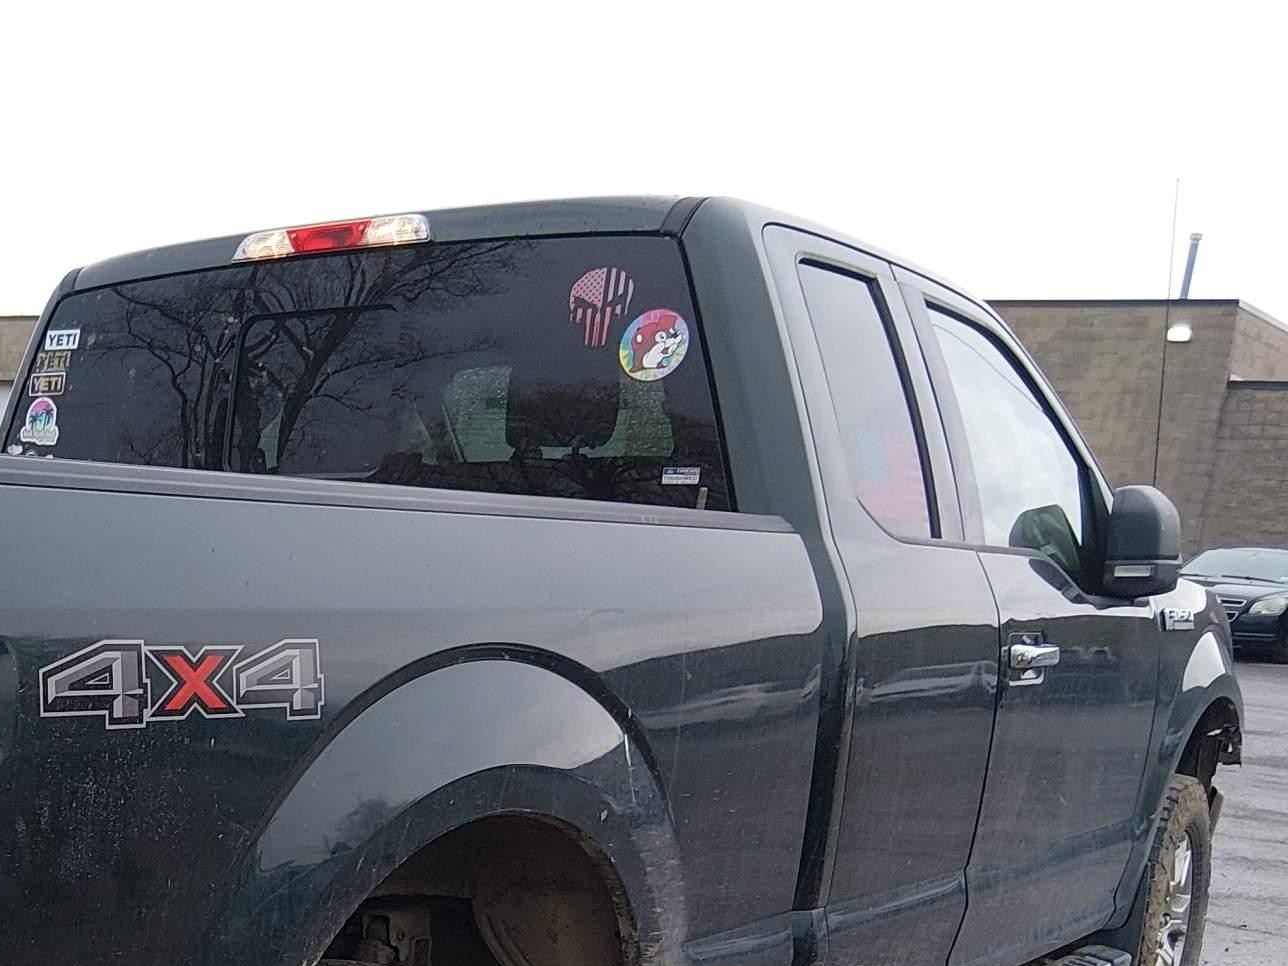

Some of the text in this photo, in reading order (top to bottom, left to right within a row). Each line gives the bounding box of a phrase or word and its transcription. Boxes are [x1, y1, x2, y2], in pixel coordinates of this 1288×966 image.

[48, 333, 77, 347] YETI
[37, 351, 71, 371] YETI
[33, 376, 63, 391] YETI
